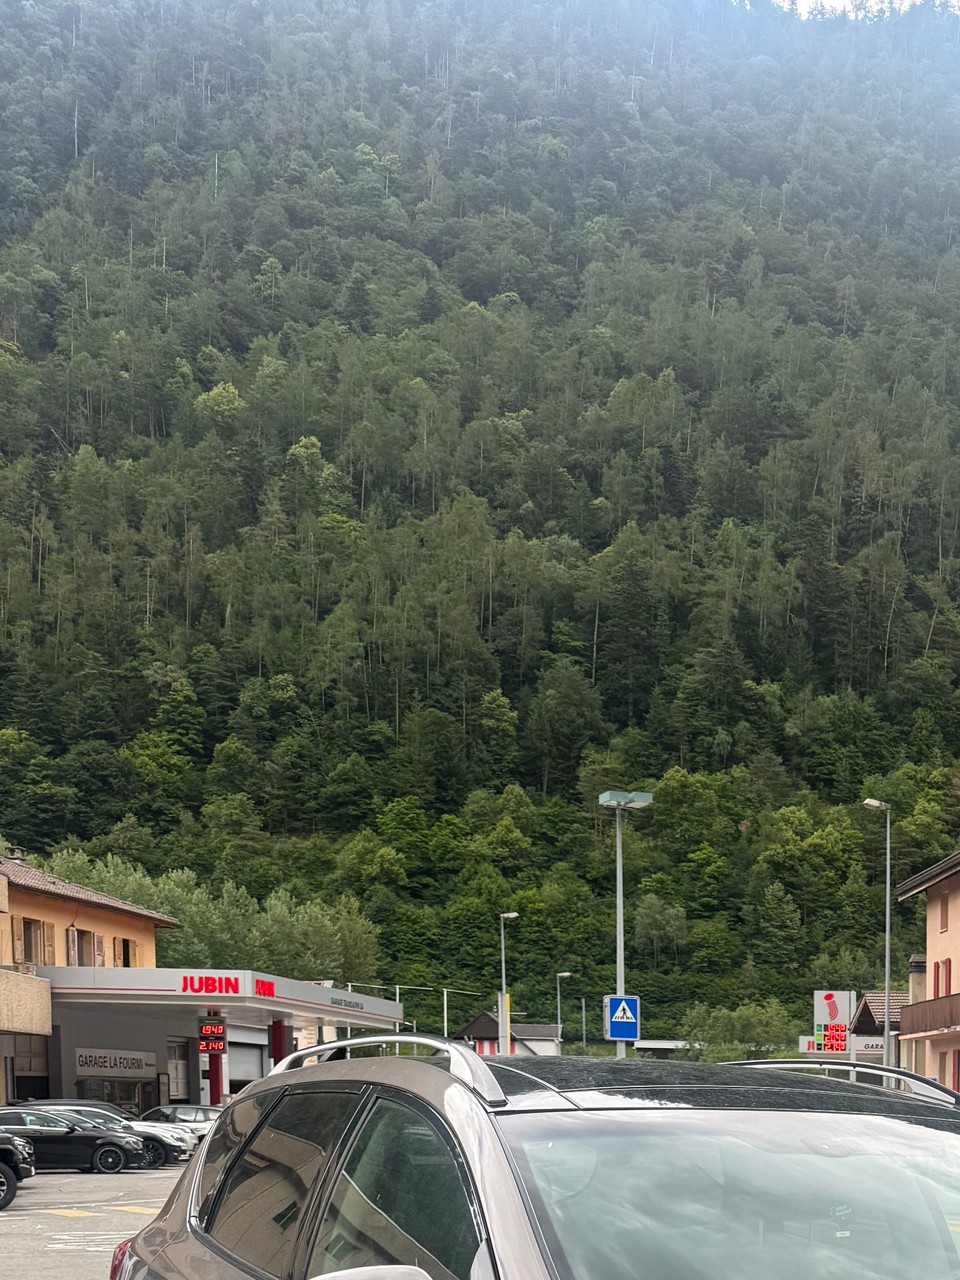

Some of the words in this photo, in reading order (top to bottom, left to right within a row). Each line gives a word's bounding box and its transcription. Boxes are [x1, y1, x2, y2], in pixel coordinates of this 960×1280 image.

[182, 976, 239, 994] JUBIN
[199, 1041, 224, 1050] 2.140
[78, 1055, 108, 1069] GARAGE
[109, 1056, 118, 1069] LA
[119, 1057, 144, 1070] FOURMI
